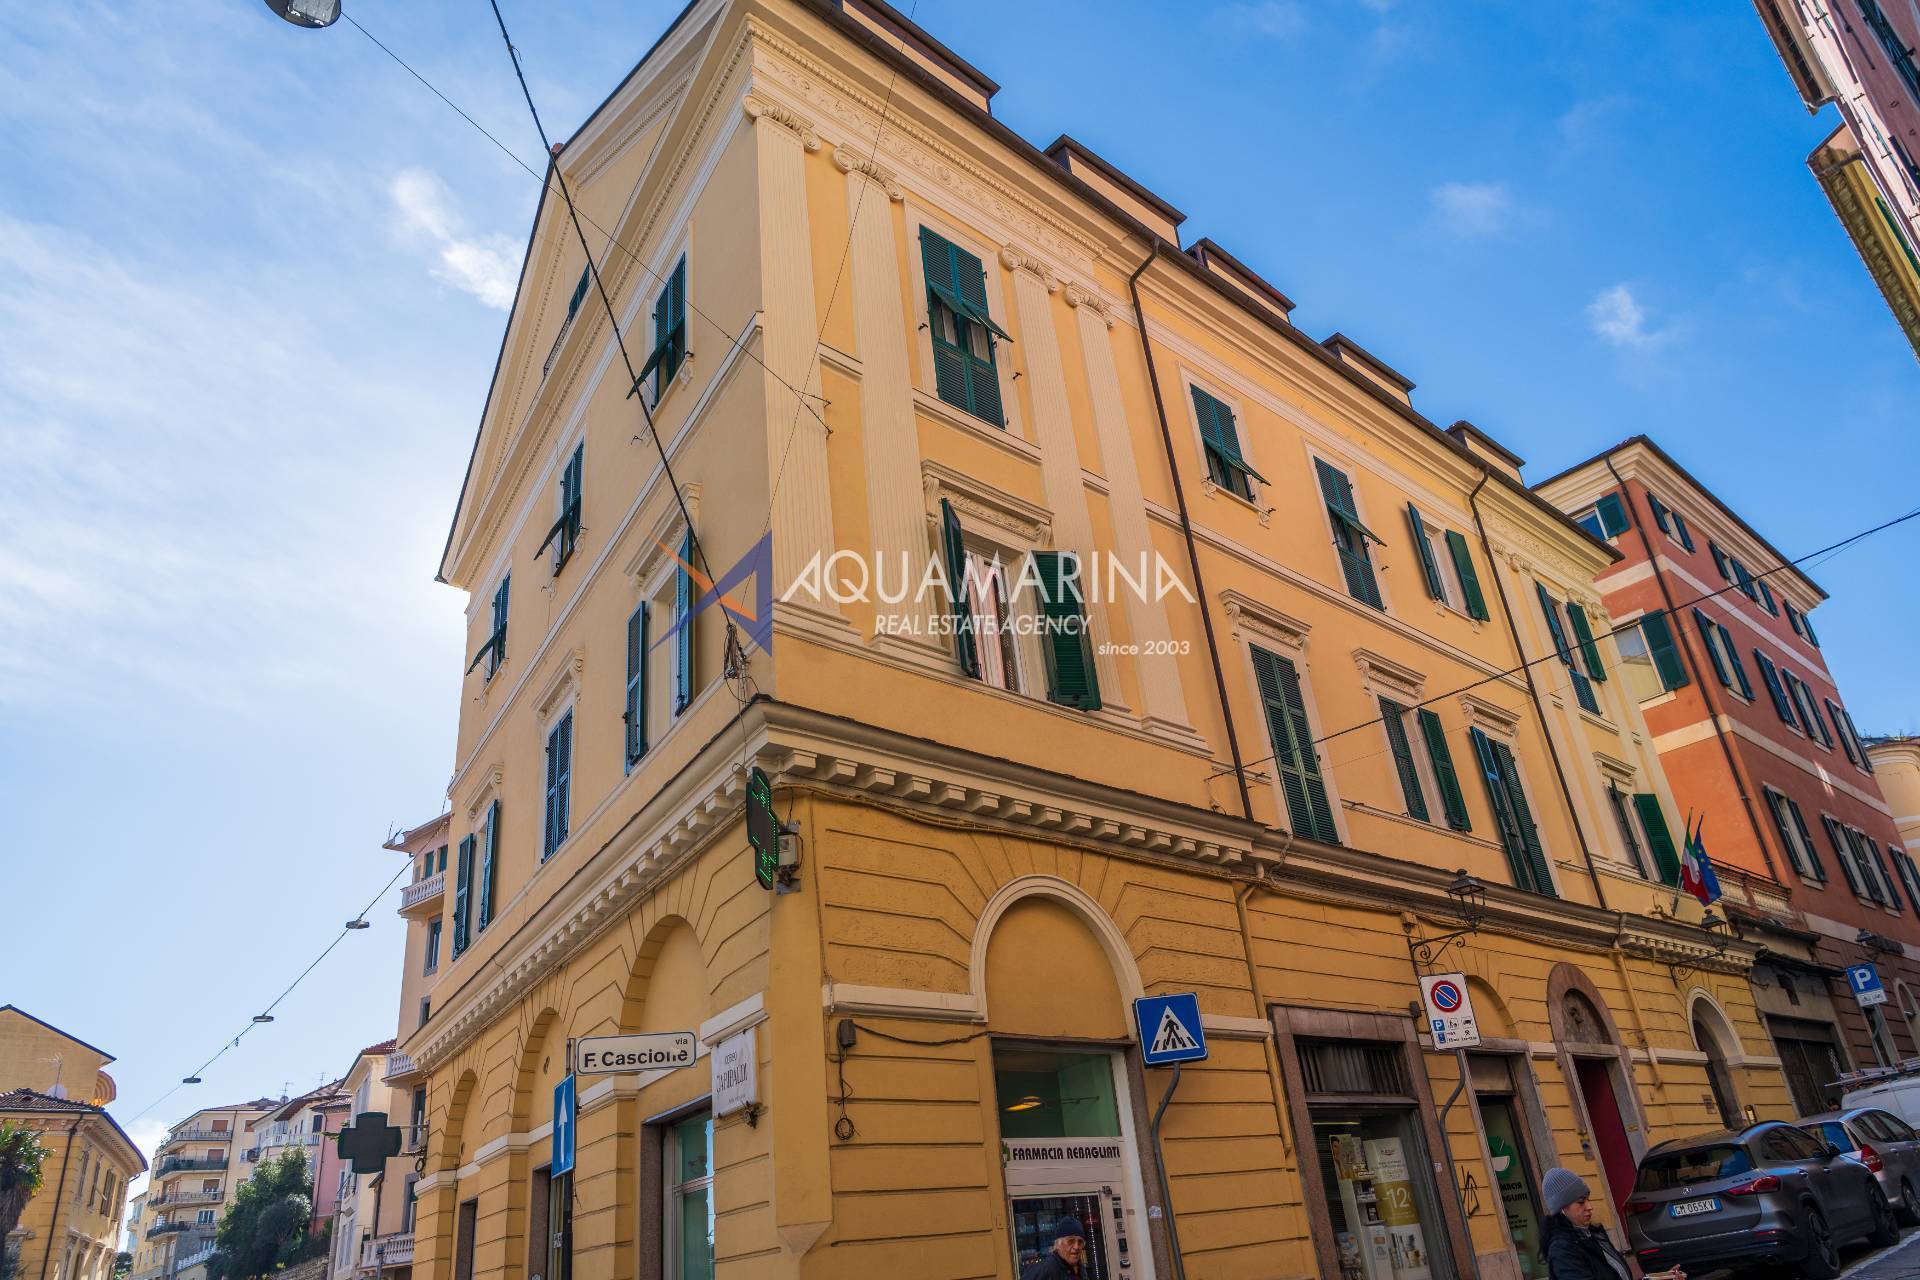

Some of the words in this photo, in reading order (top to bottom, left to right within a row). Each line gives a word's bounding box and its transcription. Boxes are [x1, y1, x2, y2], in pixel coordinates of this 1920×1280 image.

[1855, 968, 1872, 990] P
[675, 1037, 688, 1045] via
[584, 1052, 597, 1068] F.
[1013, 1147, 1064, 1160] FARMACIA
[1067, 1145, 1120, 1159] REBAGLIATI
